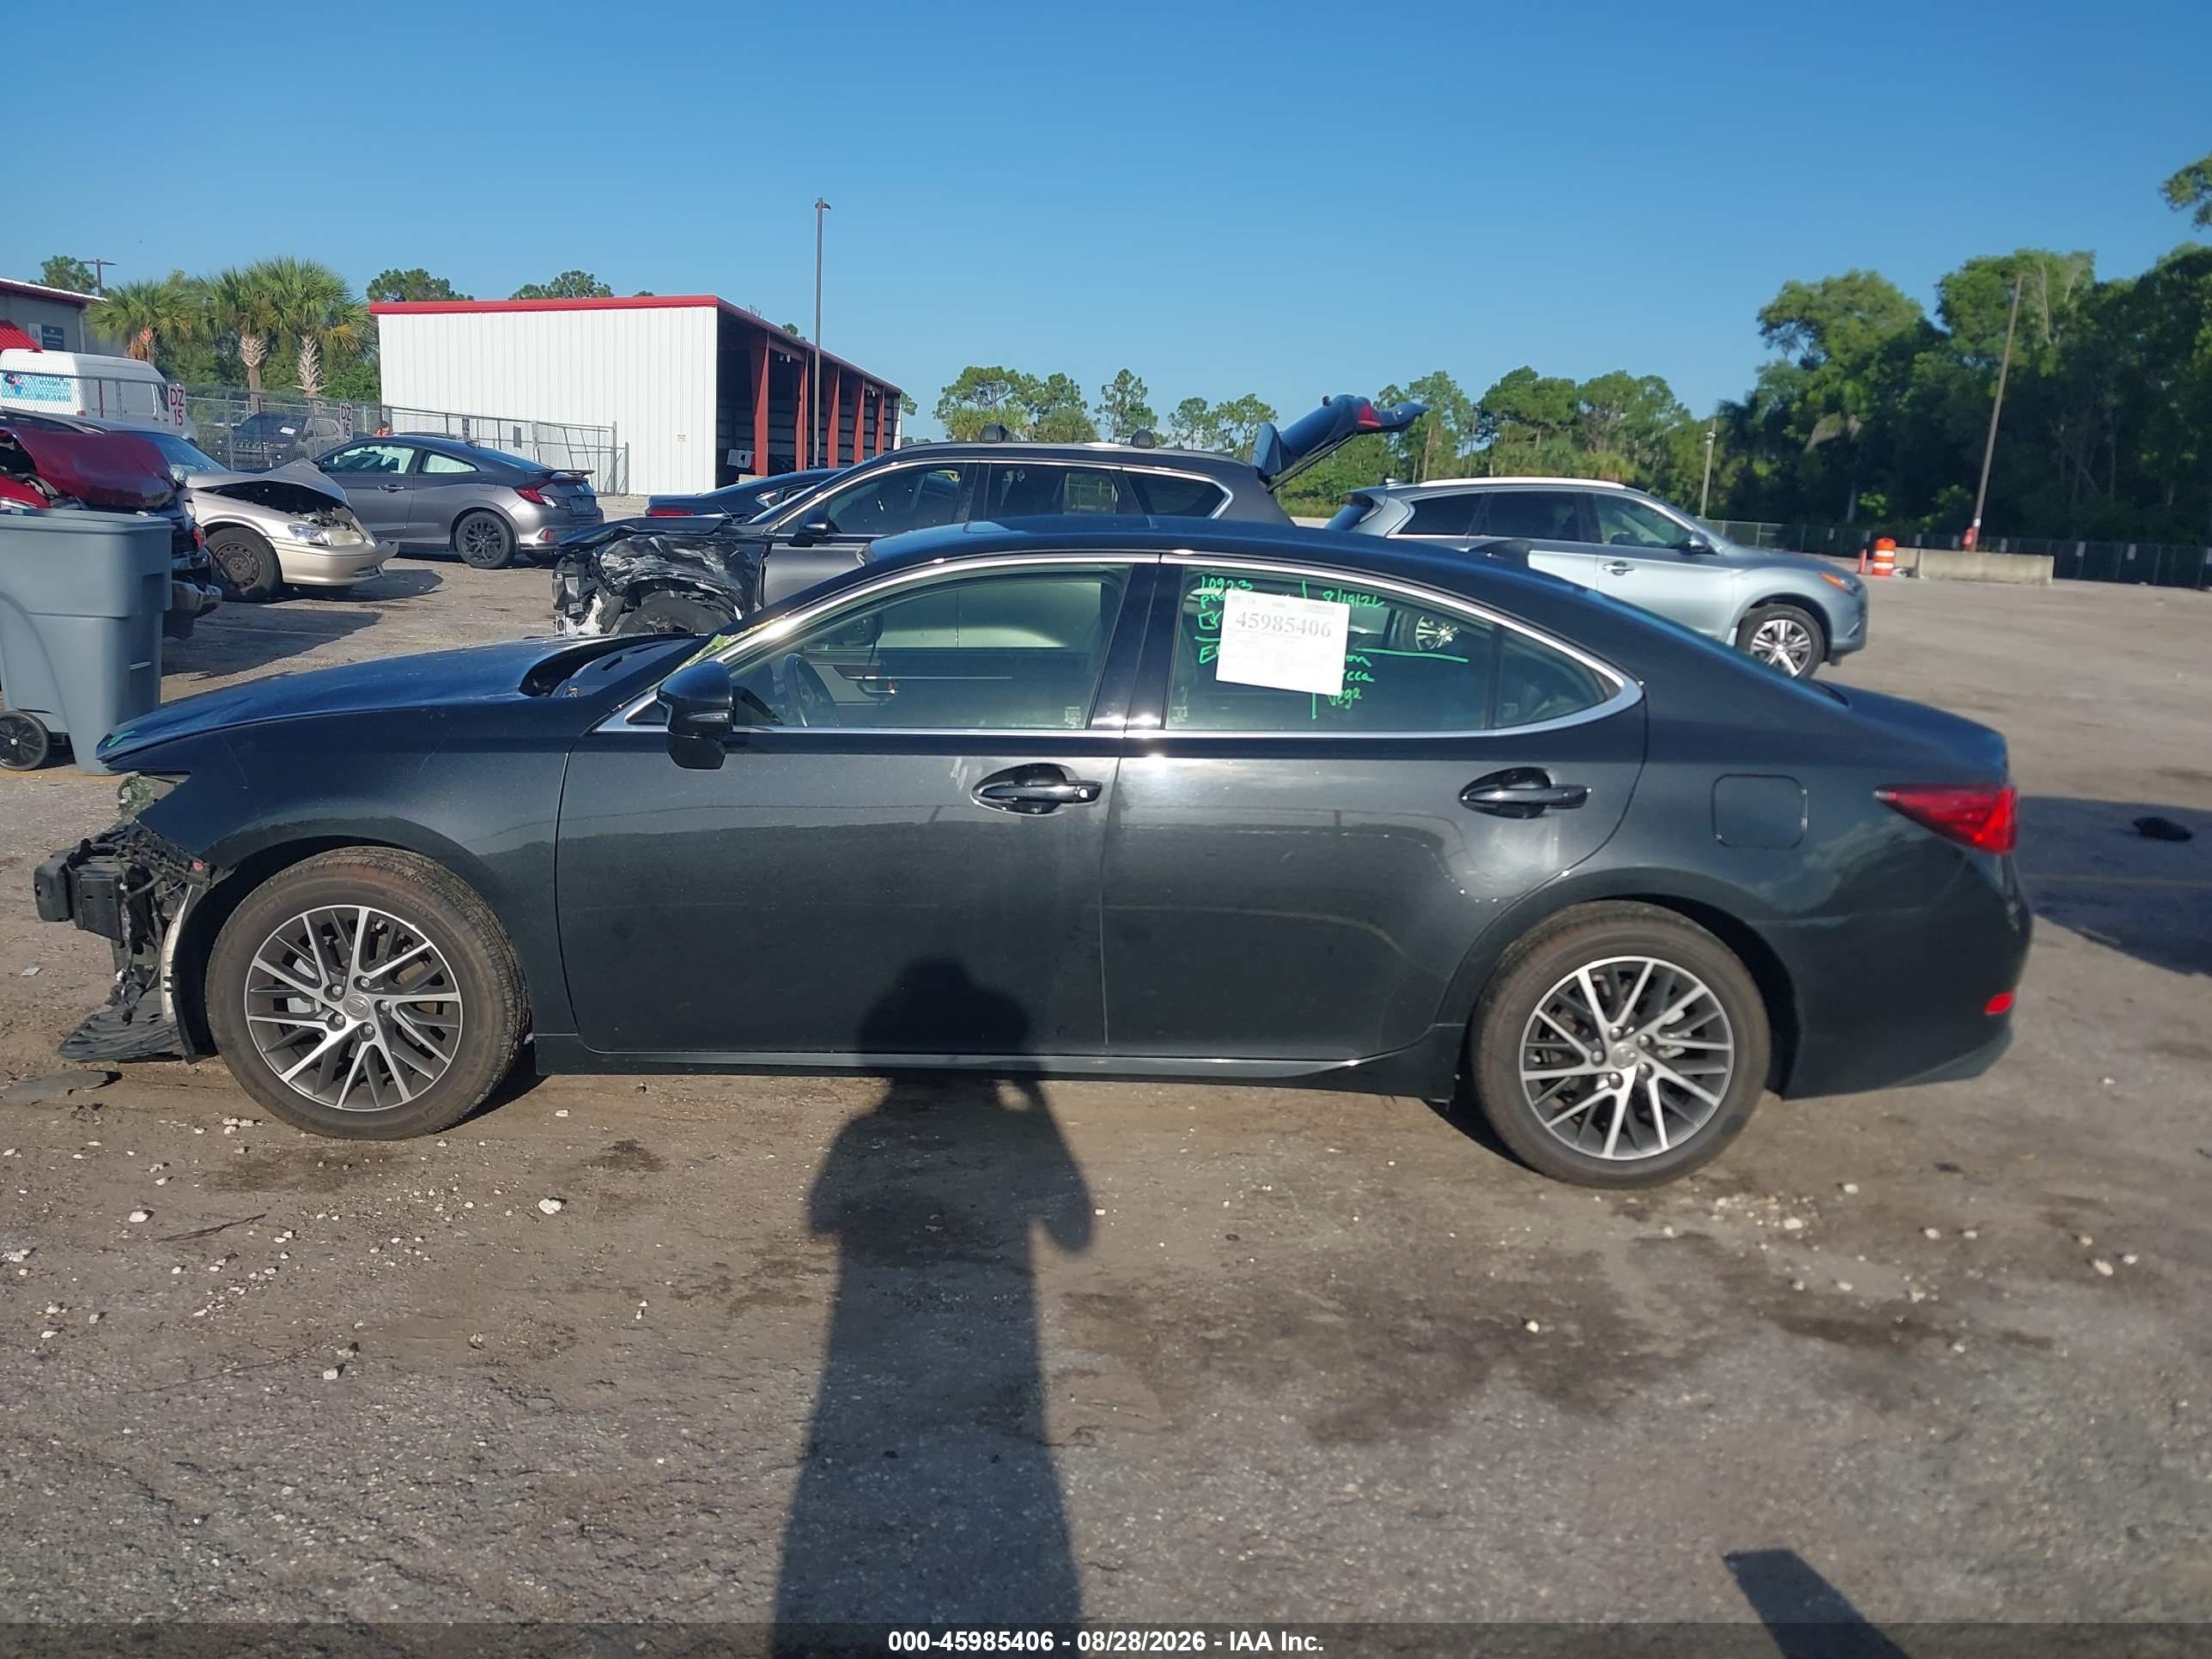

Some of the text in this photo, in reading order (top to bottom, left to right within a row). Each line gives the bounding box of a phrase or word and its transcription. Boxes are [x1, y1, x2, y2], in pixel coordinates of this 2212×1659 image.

[170, 387, 185, 407] DZ
[173, 409, 184, 426] 15
[341, 405, 352, 421] DZ
[343, 422, 350, 437] 16
[1236, 611, 1332, 638] 45985406
